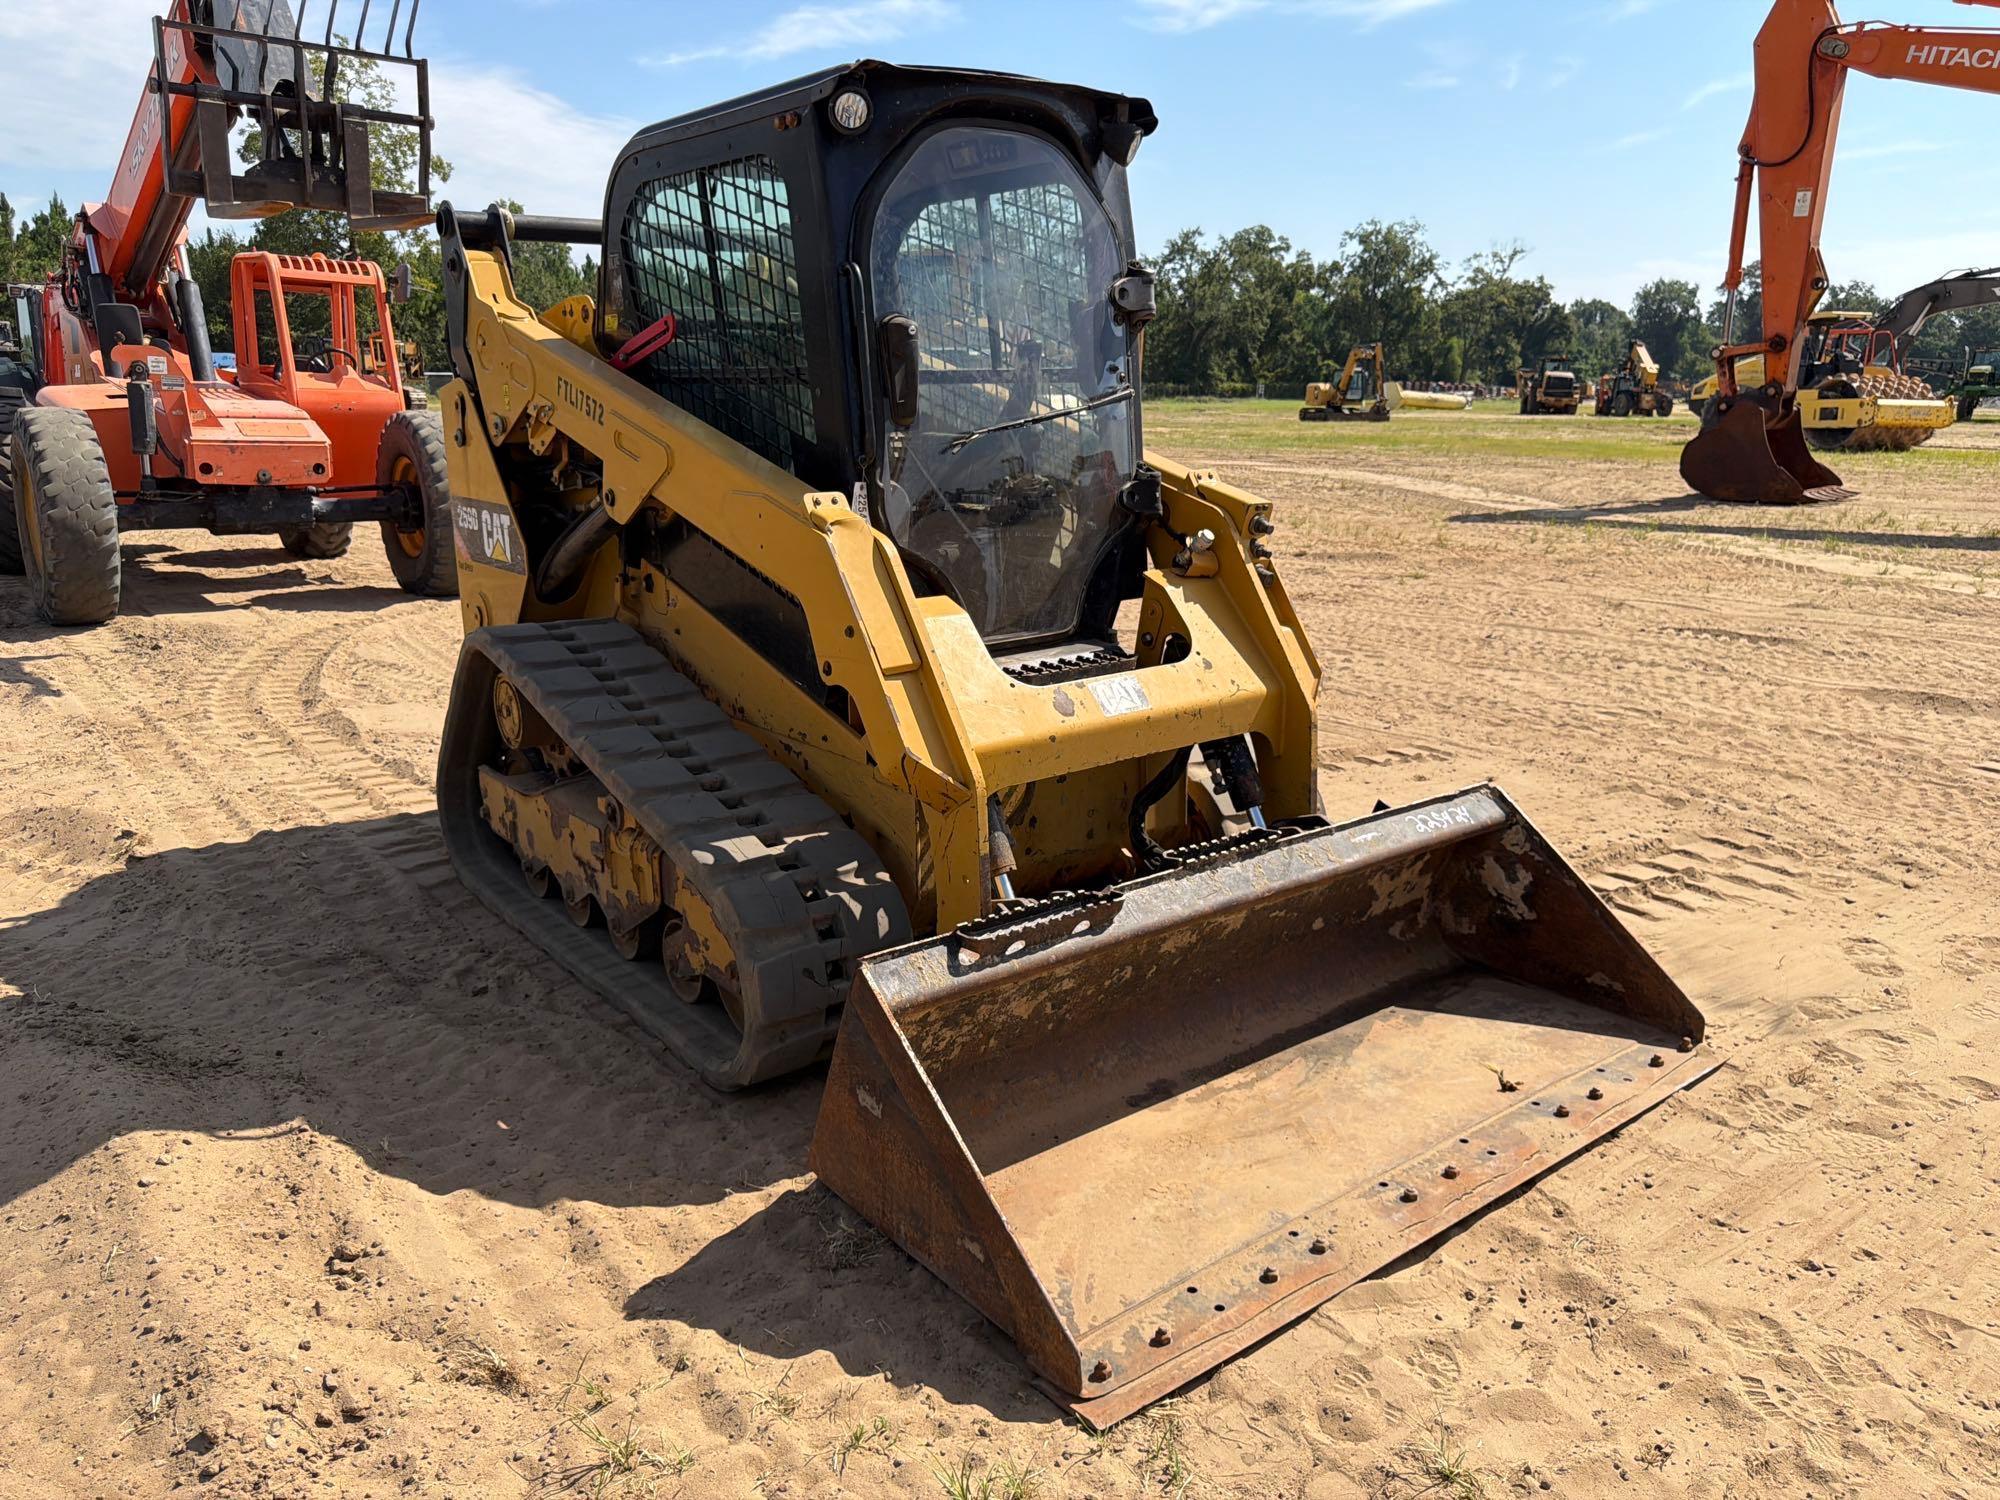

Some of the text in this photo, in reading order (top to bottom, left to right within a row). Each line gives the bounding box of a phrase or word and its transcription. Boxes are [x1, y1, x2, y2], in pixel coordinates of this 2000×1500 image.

[557, 375, 604, 426] FTL17572
[457, 505, 512, 564] 259D CAT
[1094, 677, 1144, 714] CAT
[1404, 805, 1475, 833] 225424
